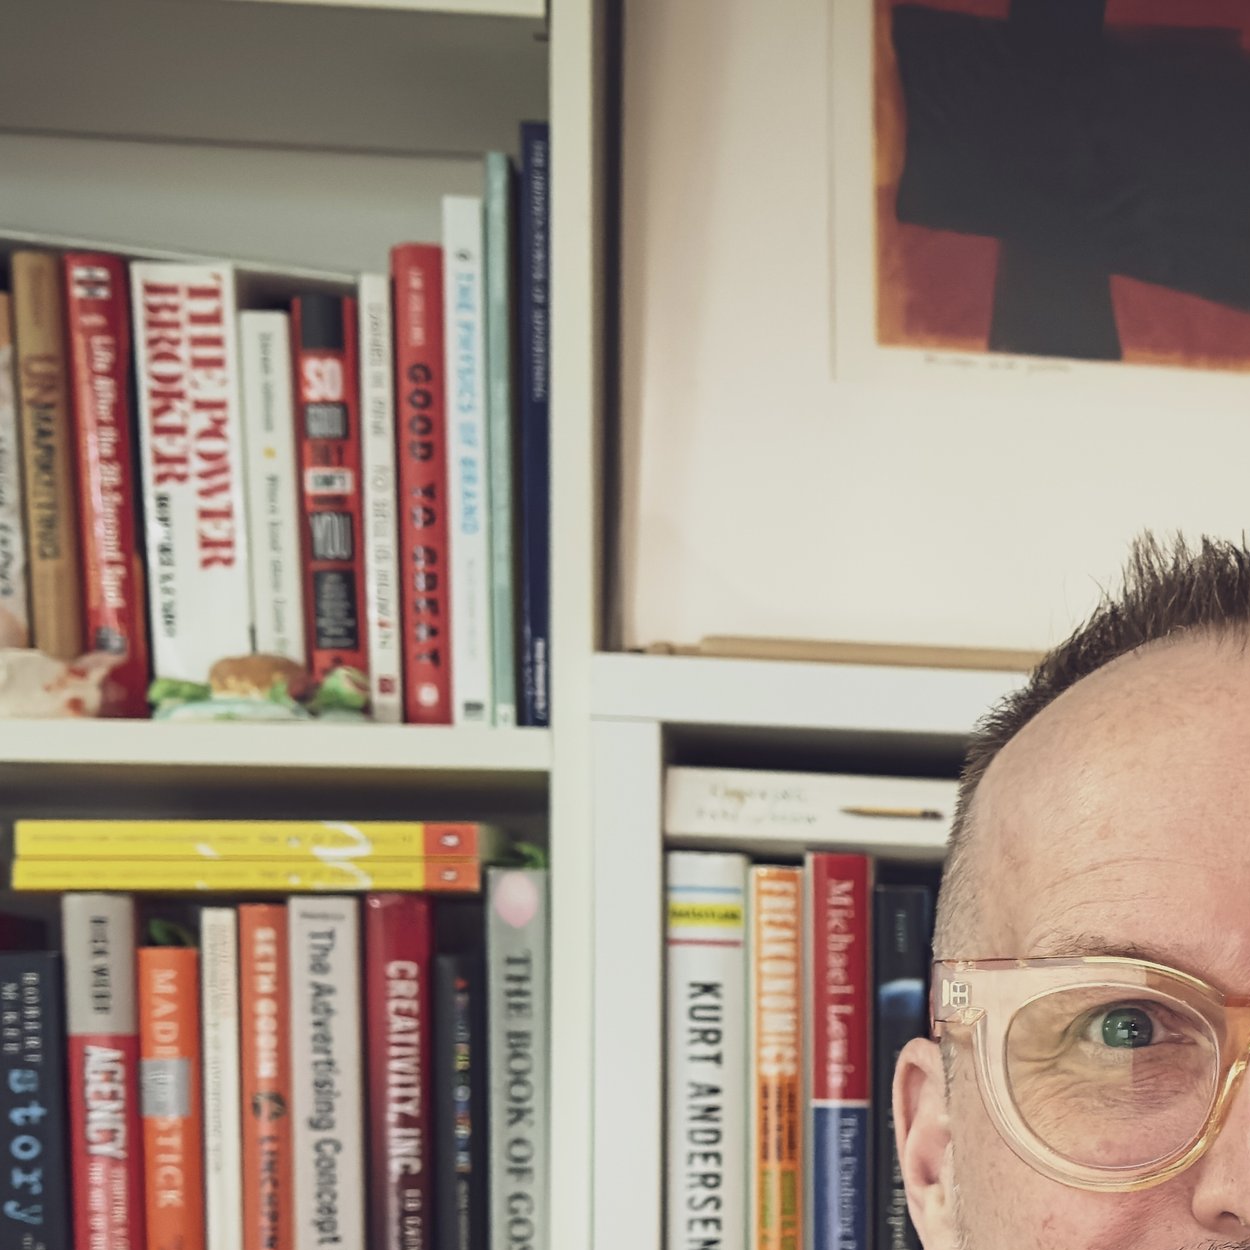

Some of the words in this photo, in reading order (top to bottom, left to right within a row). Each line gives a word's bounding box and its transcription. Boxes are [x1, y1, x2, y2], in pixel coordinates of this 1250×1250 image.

[188, 273, 227, 391] THE
[143, 283, 190, 486] BROKER
[408, 363, 433, 462] GOOD
[193, 399, 238, 571] POWER
[411, 483, 436, 530] TO
[414, 545, 440, 668] GREAT
[254, 926, 278, 994] SETH
[308, 927, 337, 977] The
[504, 950, 535, 1019] THE
[758, 880, 798, 1078] FREAKONOMICS
[826, 878, 855, 995] Michael
[308, 980, 341, 1132] Advertising
[688, 982, 723, 1067] KURT
[827, 1004, 856, 1090] Lewis
[83, 1045, 128, 1161] AGENCY
[505, 1028, 536, 1129] BOOK
[311, 1137, 343, 1247] Concept
[387, 1127, 423, 1183] INC.
[506, 1137, 536, 1185] OF
